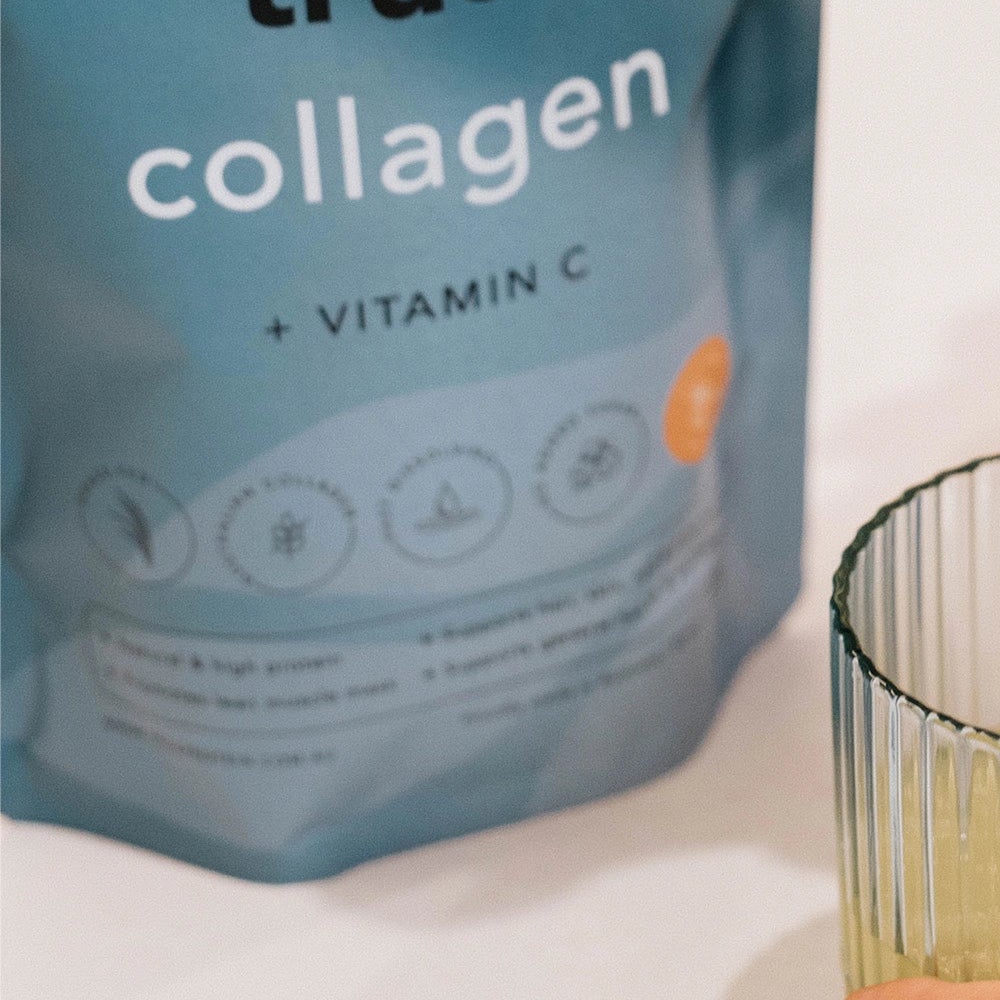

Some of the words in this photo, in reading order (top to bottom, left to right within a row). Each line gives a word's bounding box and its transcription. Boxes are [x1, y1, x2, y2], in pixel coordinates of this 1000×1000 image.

[127, 47, 671, 220] collagen
[265, 313, 291, 342] +
[316, 262, 539, 337] VITAMIN
[558, 242, 591, 282] C
